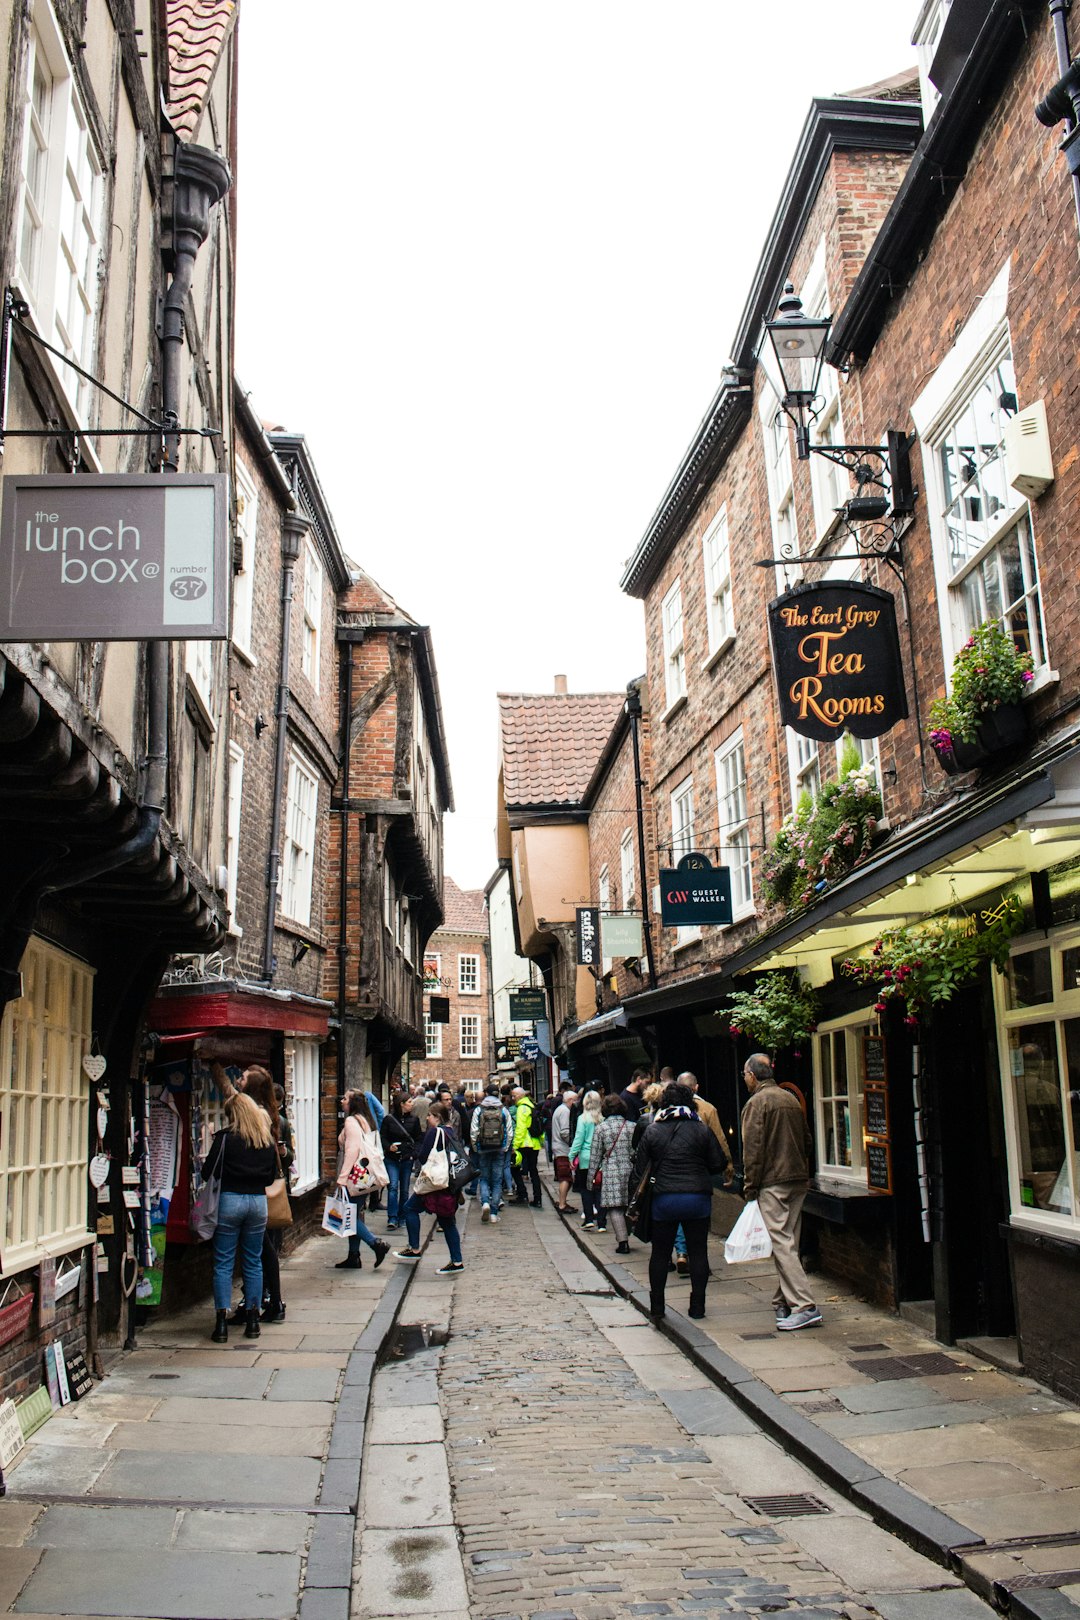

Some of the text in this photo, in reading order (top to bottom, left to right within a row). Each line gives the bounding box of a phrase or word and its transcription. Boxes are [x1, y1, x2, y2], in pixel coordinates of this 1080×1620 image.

[35, 511, 59, 523] the
[25, 519, 141, 551] lunch
[169, 564, 208, 574] number
[173, 580, 204, 598] 37
[780, 604, 881, 629] The Earl Grey
[797, 626, 866, 677] Tea
[789, 676, 886, 727] Rooms
[692, 895, 726, 903] WALKER
